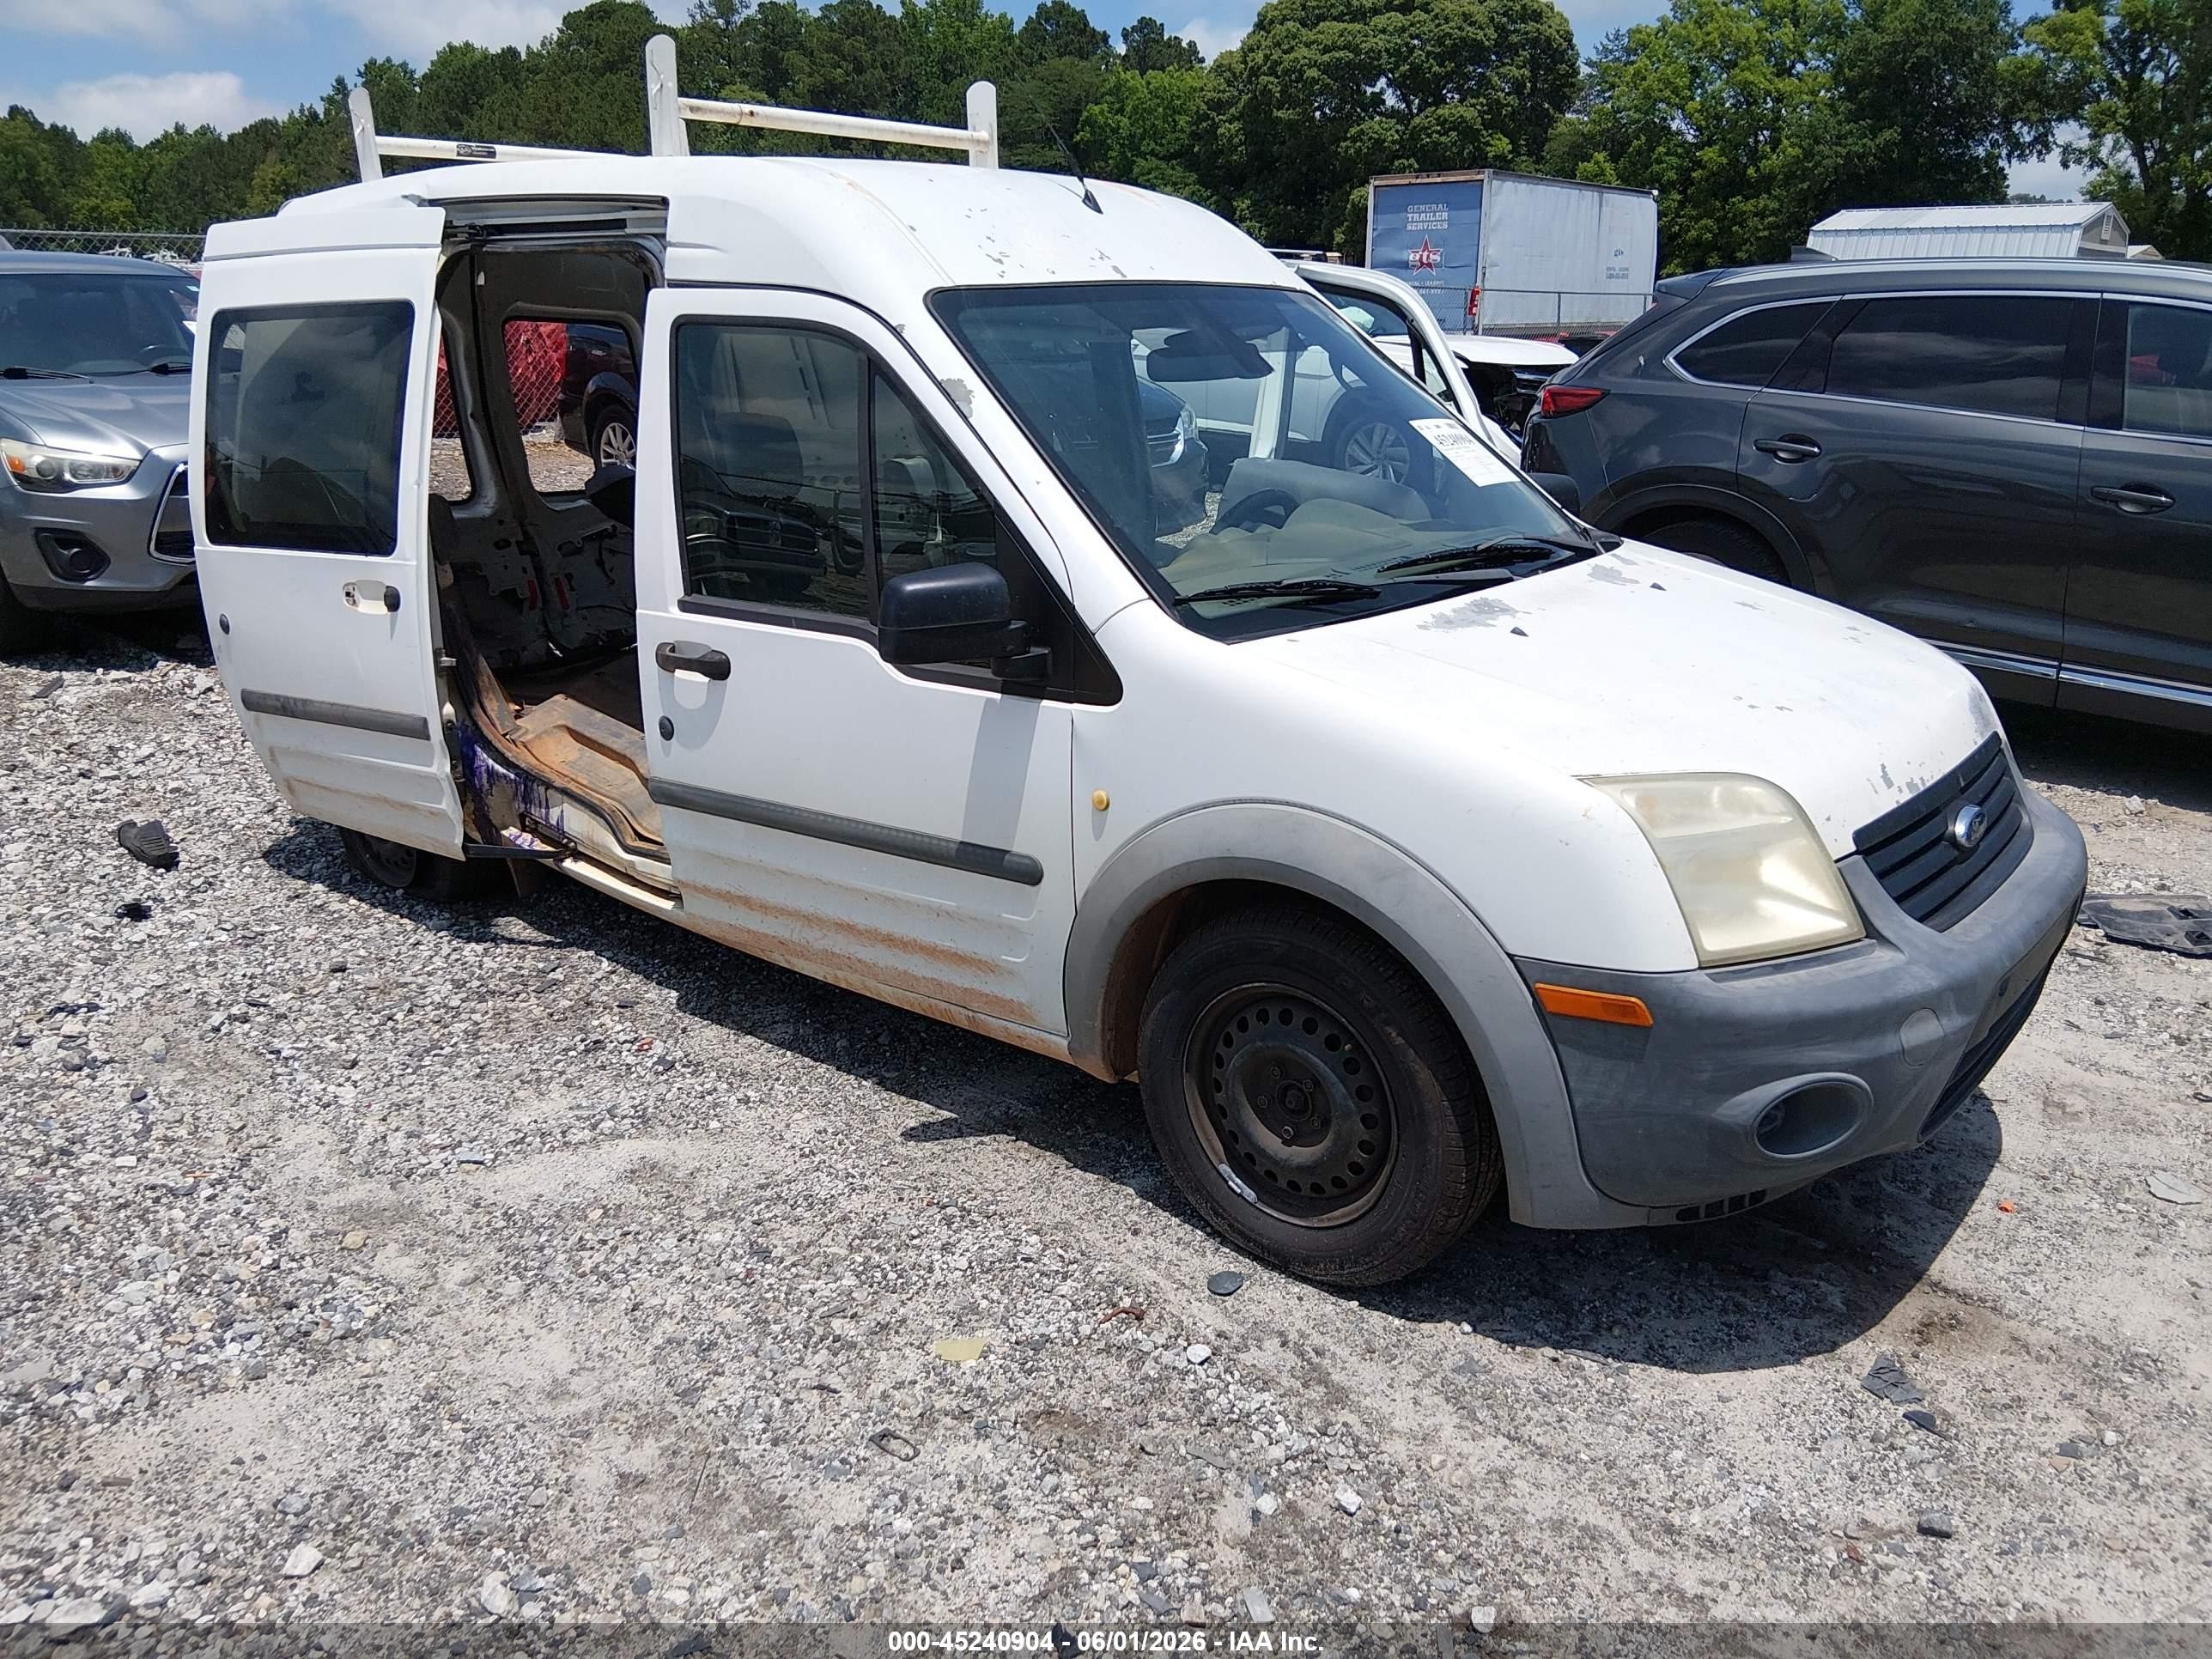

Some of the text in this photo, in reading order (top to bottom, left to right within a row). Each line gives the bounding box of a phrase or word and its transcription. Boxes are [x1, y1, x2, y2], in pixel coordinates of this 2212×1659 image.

[1407, 204, 1449, 213] GENERAL
[1407, 212, 1449, 222] TRAILER
[1407, 222, 1449, 231] SERVICES
